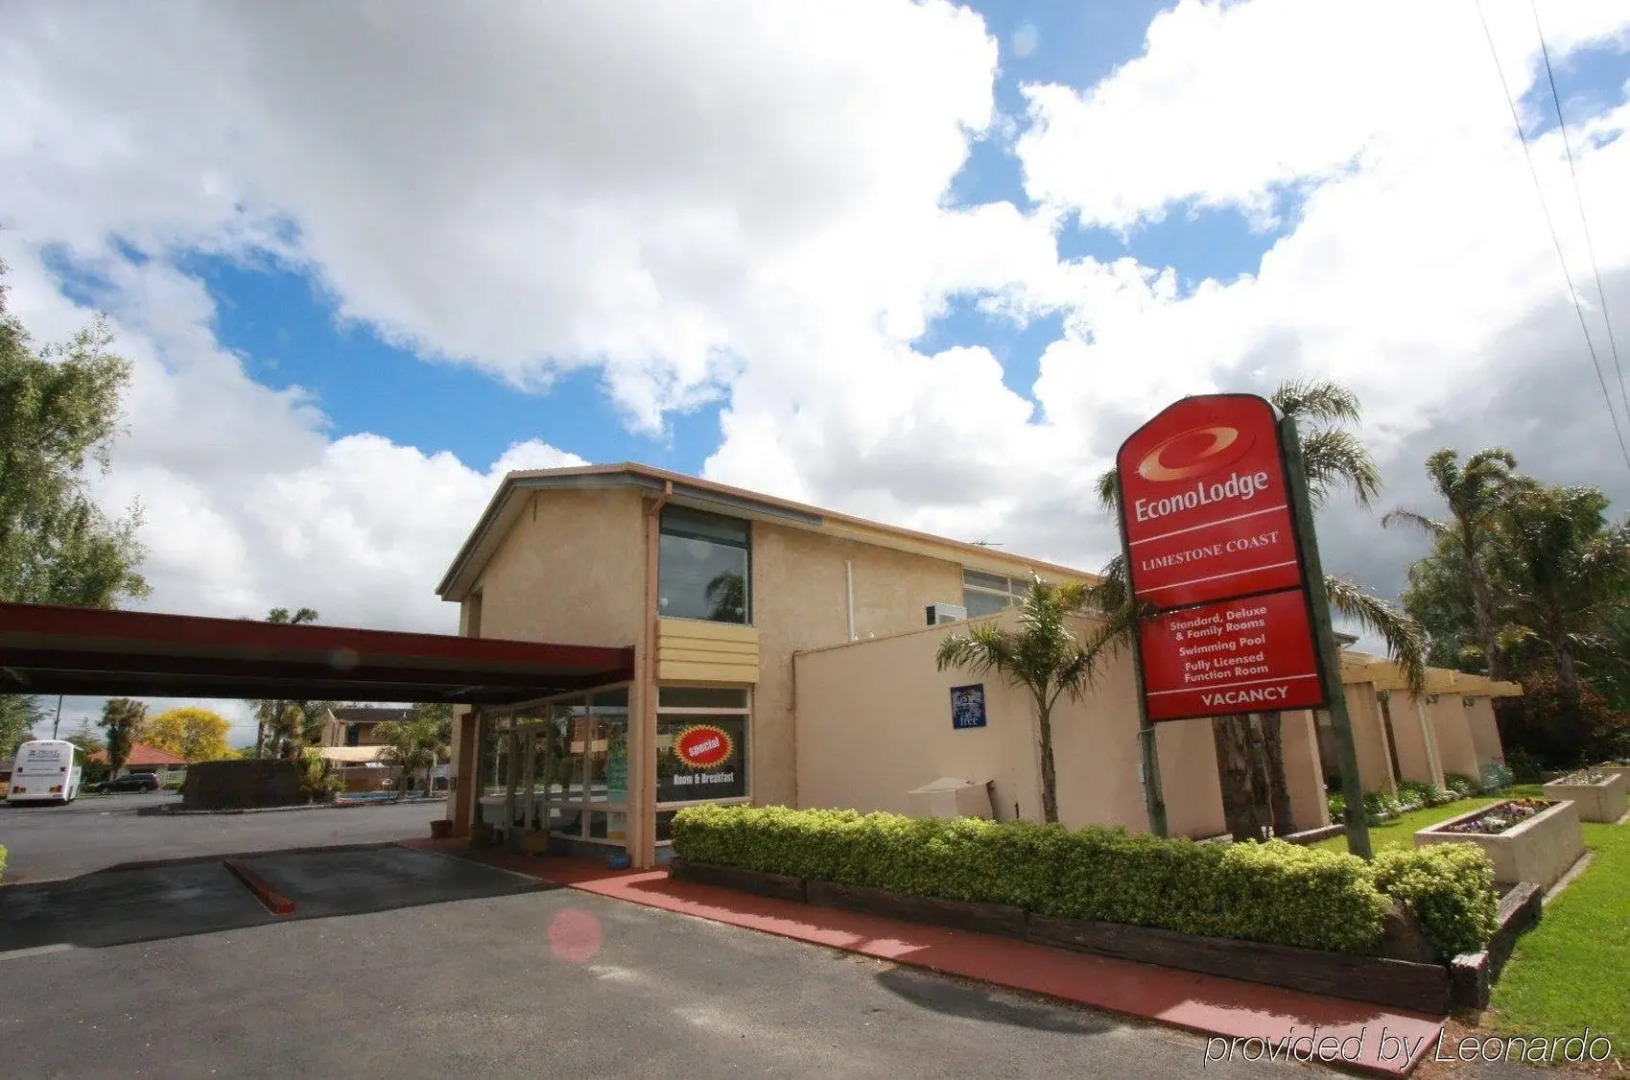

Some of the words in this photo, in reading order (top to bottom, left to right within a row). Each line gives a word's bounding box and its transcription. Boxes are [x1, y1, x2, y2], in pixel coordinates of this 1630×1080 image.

[1135, 471, 1269, 522] EconoLodge
[1142, 544, 1223, 571] LIMESTONE
[1226, 531, 1279, 553] COAST
[1170, 613, 1223, 631] Standard,
[1226, 605, 1267, 620] Deluxe
[1176, 631, 1184, 641] &
[1187, 625, 1222, 639] Family
[1226, 618, 1265, 632] Rooms
[1179, 641, 1236, 657] Swimming
[1239, 633, 1266, 647] Pool
[1185, 659, 1210, 672] Fully
[1214, 651, 1264, 668] Licensed
[1184, 669, 1231, 683] Function
[1235, 664, 1269, 677] Room
[1201, 686, 1289, 706] VACANCY
[688, 736, 720, 757] special
[673, 773, 694, 785] Room
[694, 773, 700, 783] &
[701, 771, 734, 783] Breakfast
